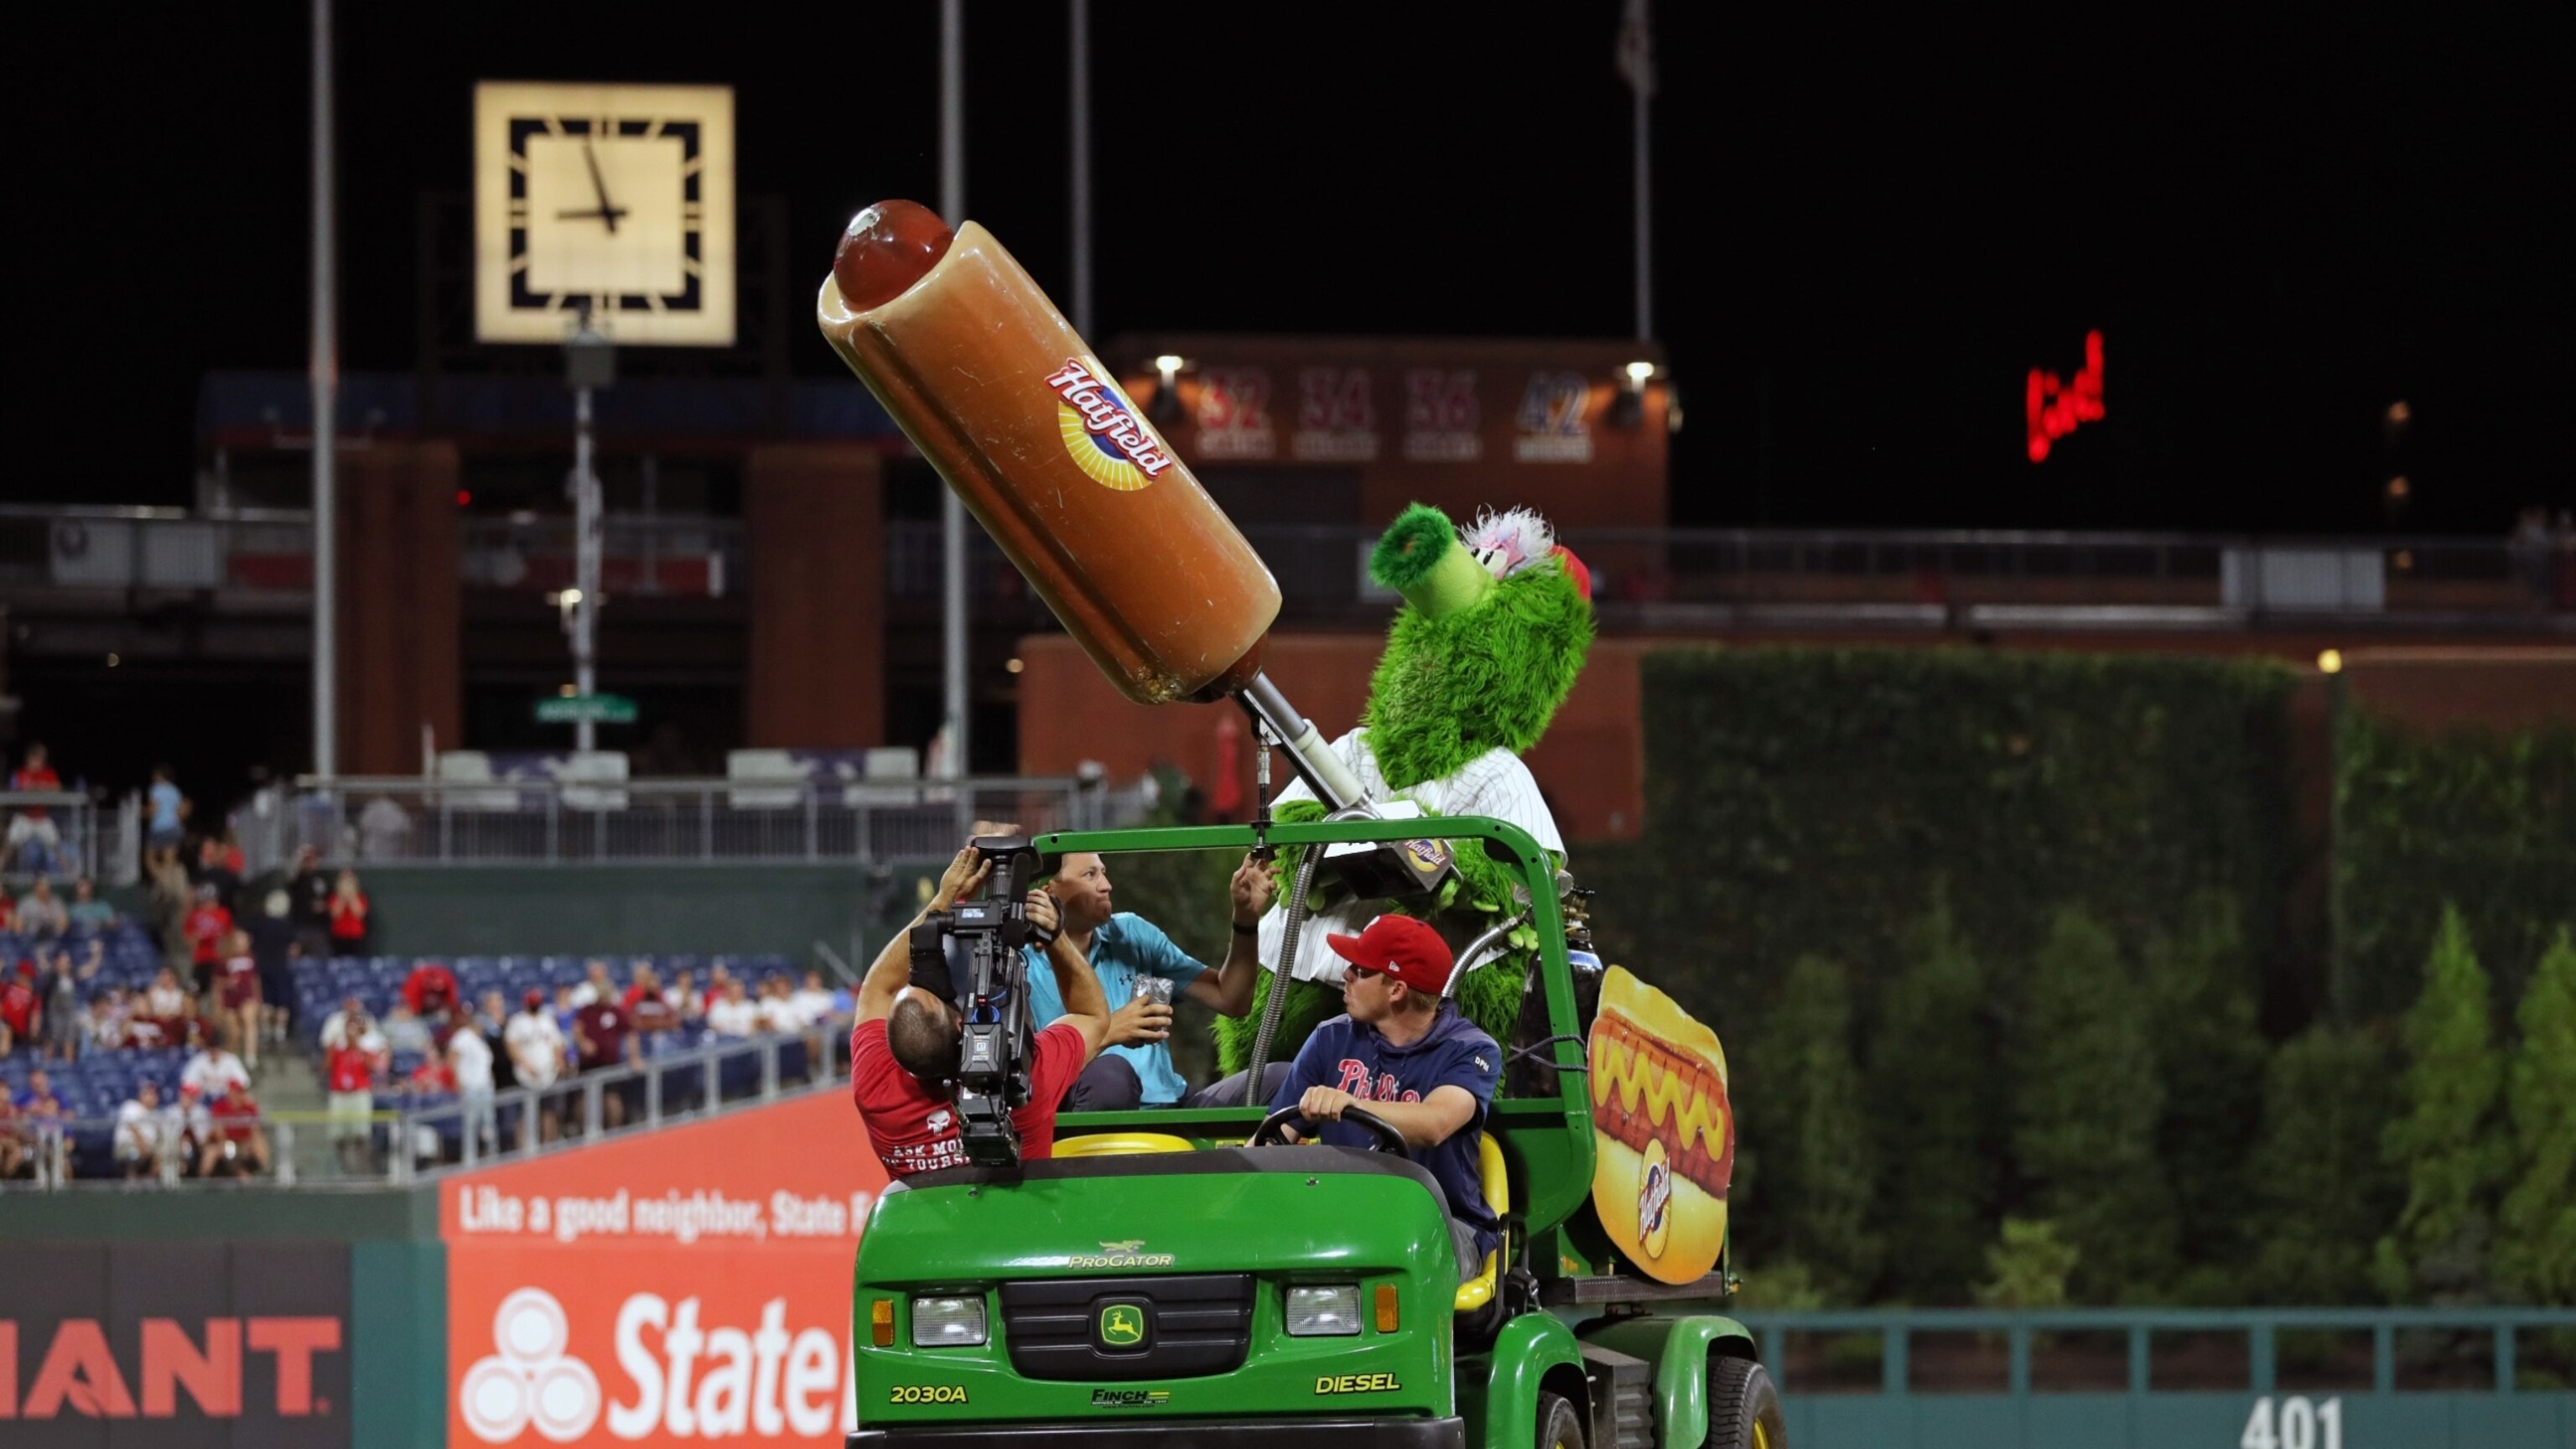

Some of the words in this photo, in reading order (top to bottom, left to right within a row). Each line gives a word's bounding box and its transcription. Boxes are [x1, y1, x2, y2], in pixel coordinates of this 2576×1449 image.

[1046, 358, 1173, 479] Hatfield
[1474, 1056, 1489, 1072] DPM
[460, 1184, 523, 1232] Like
[528, 1195, 550, 1233] a
[554, 1187, 628, 1243] good
[633, 1188, 766, 1243] neighbor,
[771, 1190, 846, 1235] State
[1639, 1154, 1670, 1242] Hatfield
[607, 1291, 839, 1442] State
[1315, 1373, 1401, 1394] DIESEL
[891, 1385, 968, 1403] 2030A
[1092, 1389, 1148, 1401] FINCH
[2240, 1396, 2343, 1449] 401
